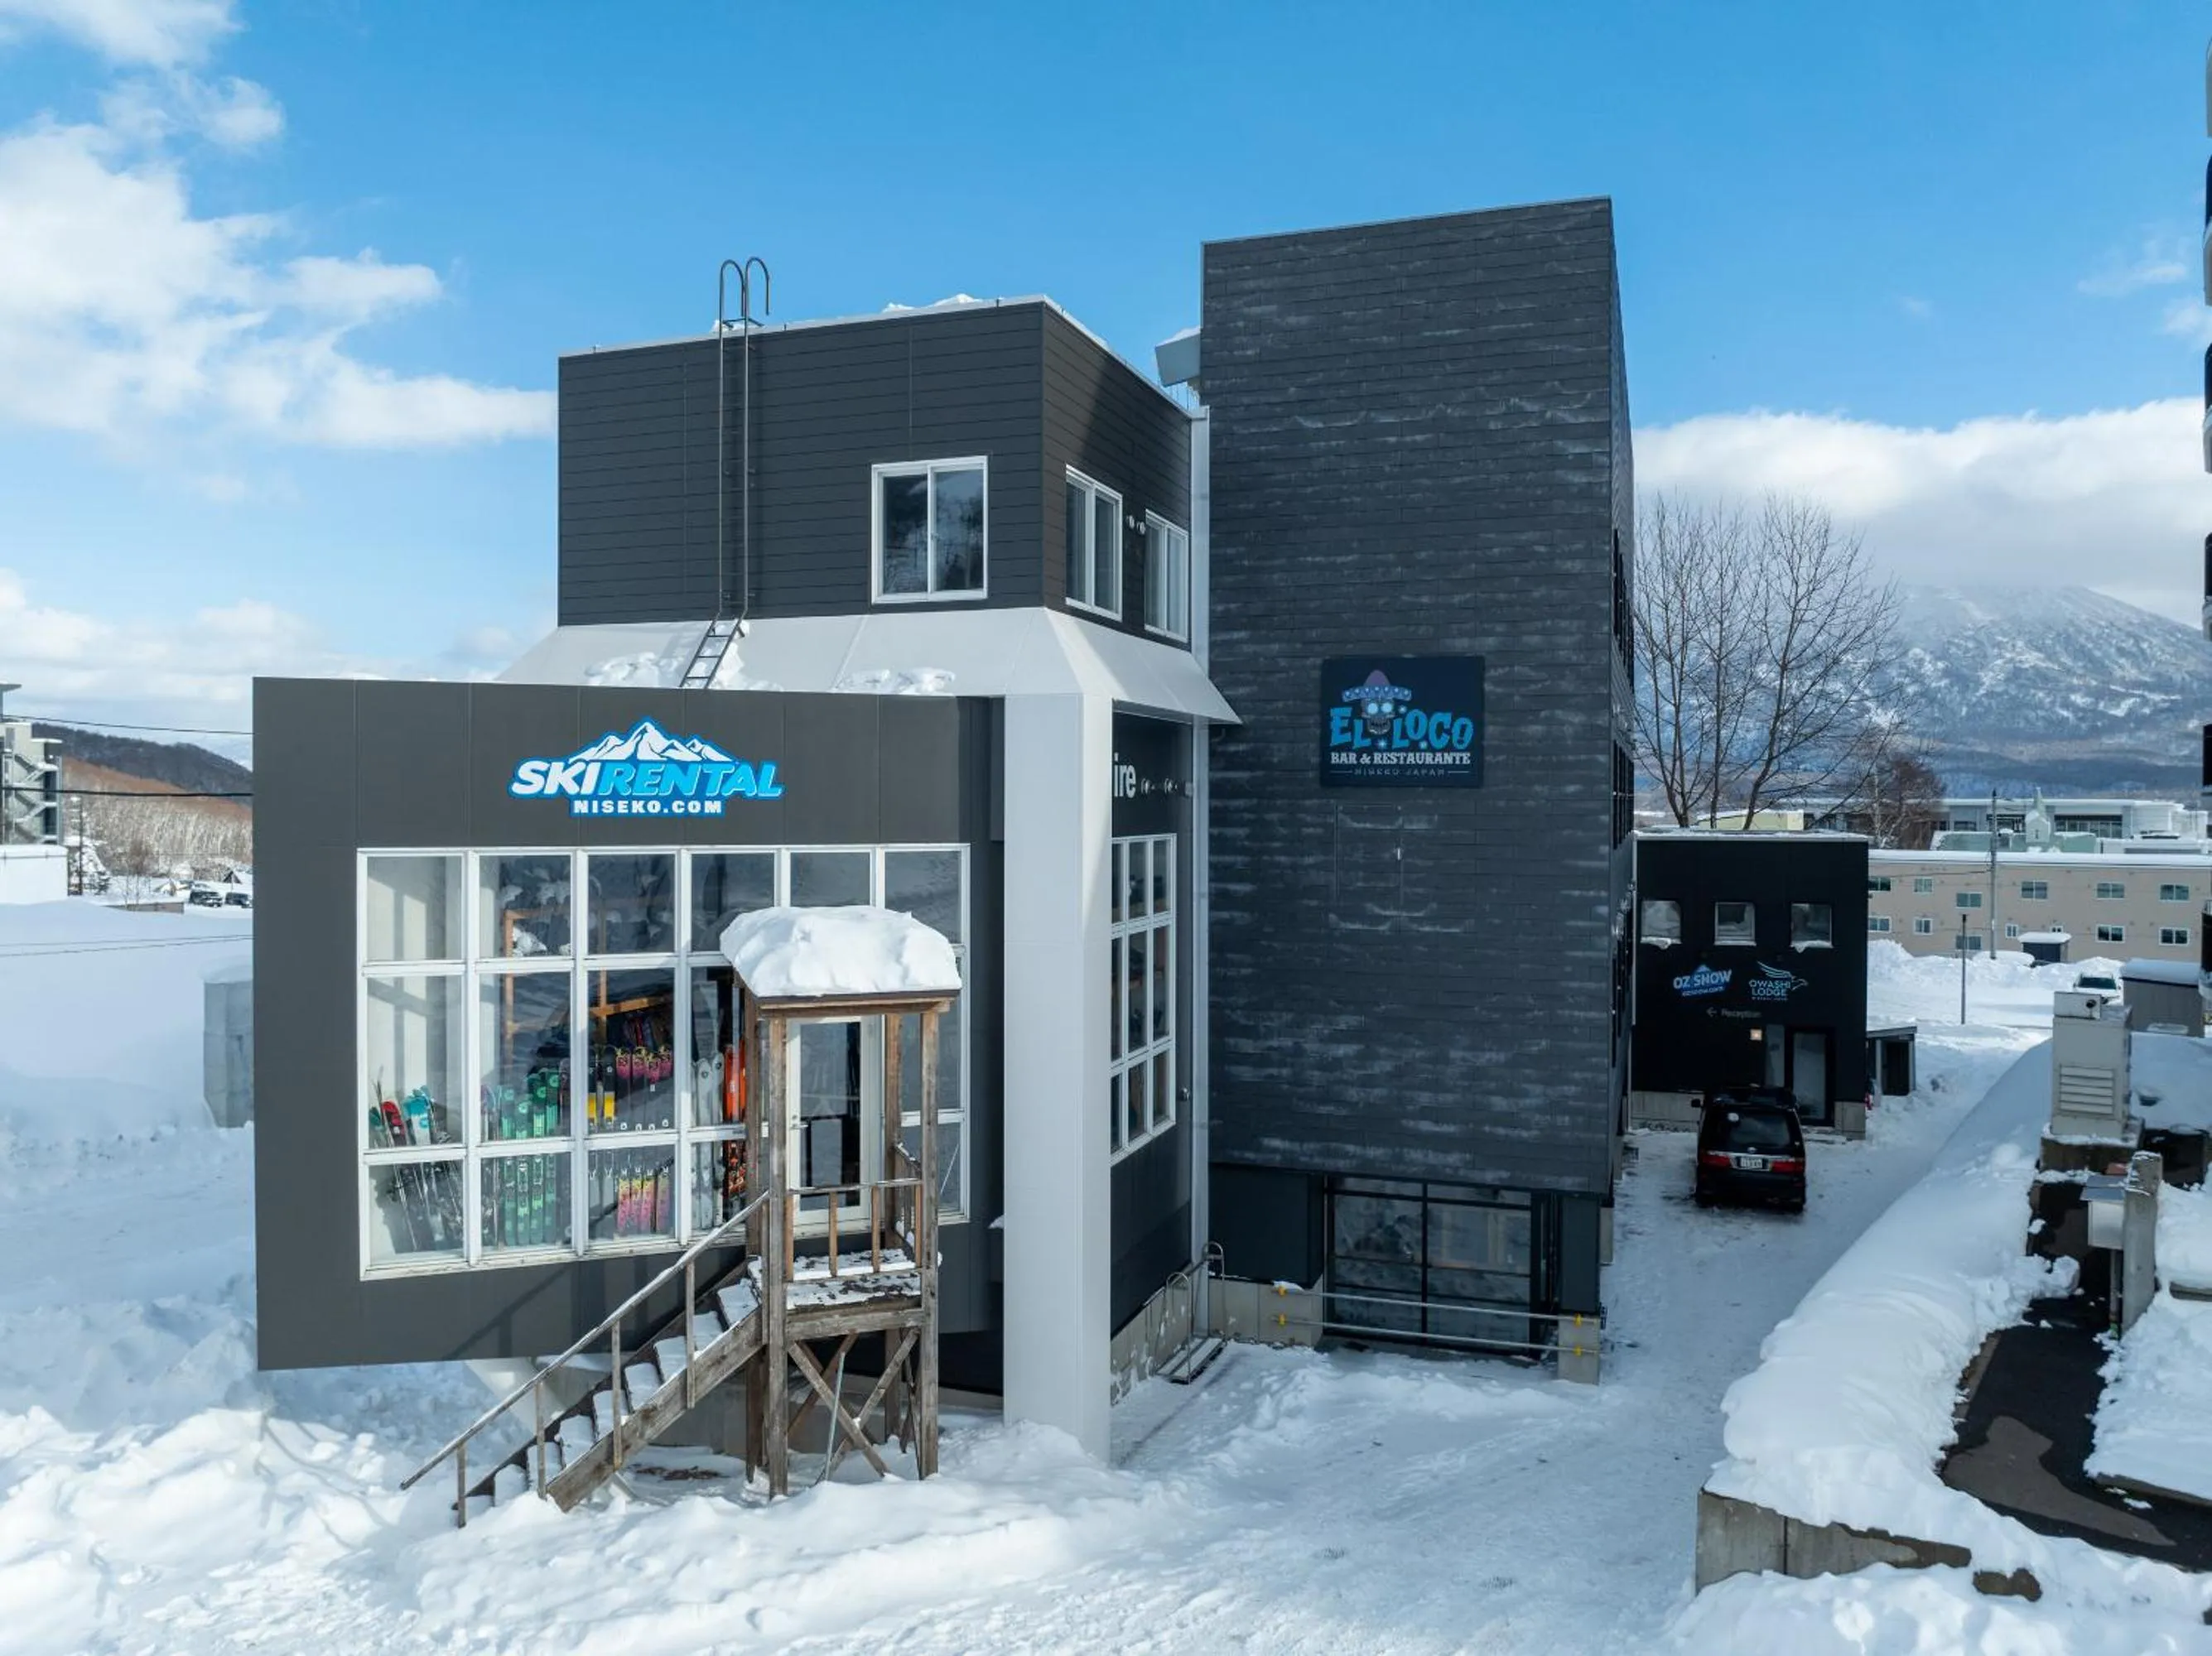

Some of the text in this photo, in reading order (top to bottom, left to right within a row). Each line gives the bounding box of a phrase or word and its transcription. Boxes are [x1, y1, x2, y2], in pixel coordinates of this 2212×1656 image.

[1391, 709, 1474, 750] LOCO
[1330, 752, 1471, 766] BAR & RESTAURANTE
[573, 800, 722, 814] NISEKO.COM
[1673, 975, 1691, 990] OZ
[1748, 979, 1791, 989] OWASHI
[1751, 988, 1788, 997] LODGE
[1721, 1008, 1762, 1020] Reception
